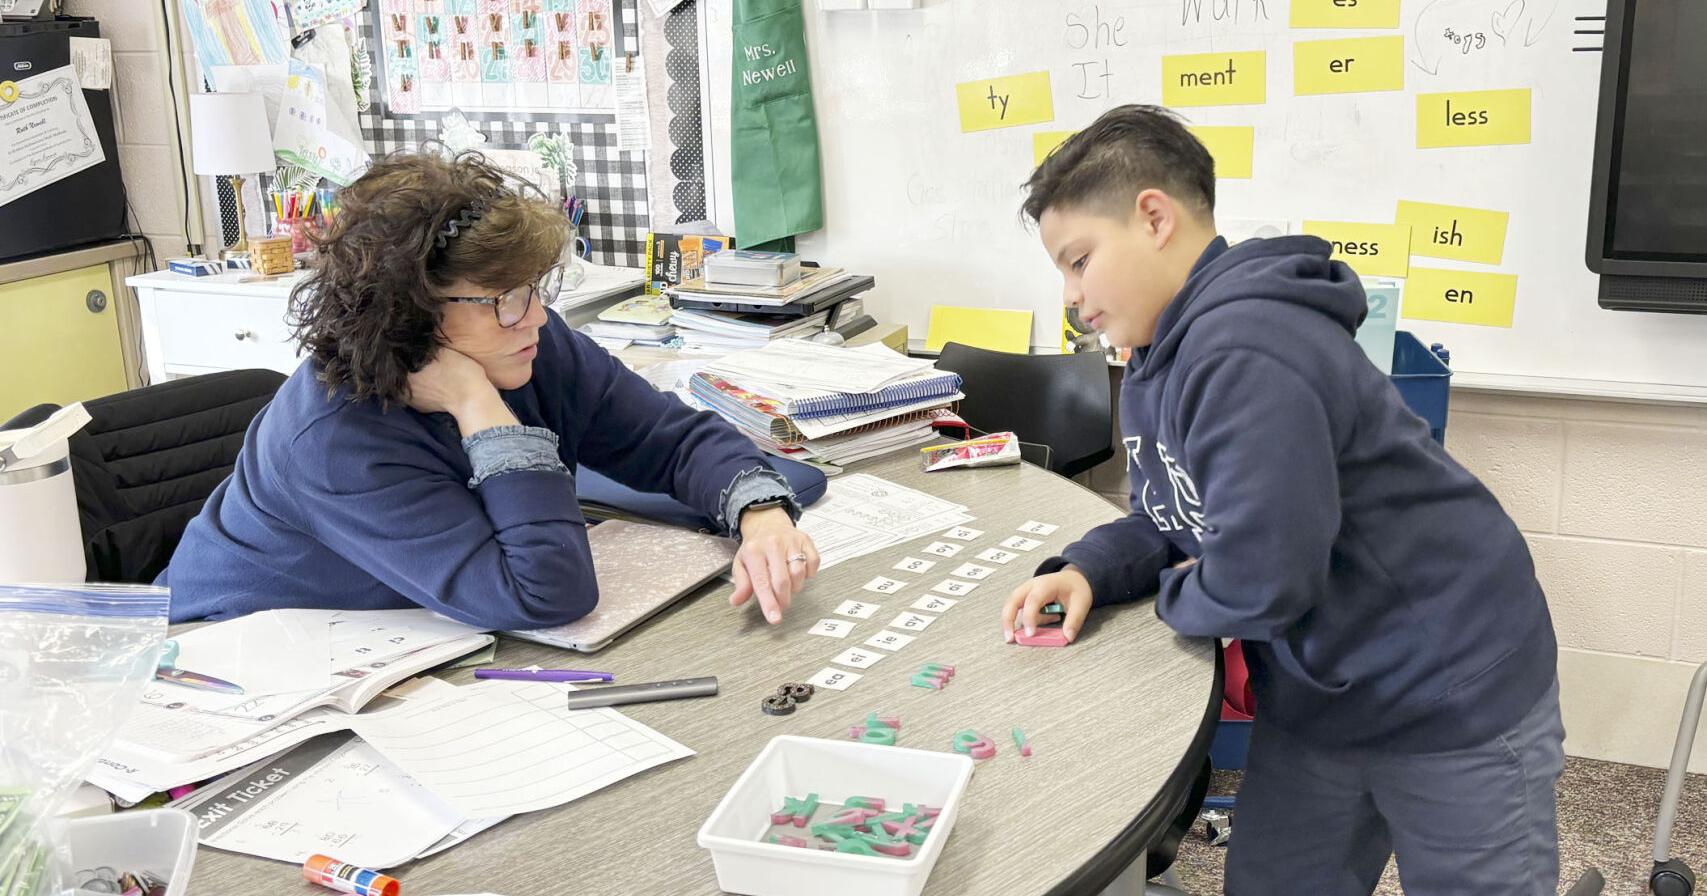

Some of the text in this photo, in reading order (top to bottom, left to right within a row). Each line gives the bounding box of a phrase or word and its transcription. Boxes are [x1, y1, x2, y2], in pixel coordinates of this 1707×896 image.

[1065, 5, 1128, 49] She
[744, 44, 776, 61] Mrs.
[743, 59, 796, 86] Newell
[1180, 59, 1237, 87] ment
[1329, 58, 1354, 73] er
[1072, 59, 1114, 99] It
[987, 85, 1009, 120] ty
[1446, 99, 1488, 126] less
[1433, 219, 1463, 246] ish
[1332, 240, 1379, 256] ness
[666, 251, 680, 281] chewy
[1367, 294, 1388, 319] 2
[1445, 289, 1473, 304] en
[926, 599, 945, 609] ey
[904, 616, 924, 627] ay
[876, 636, 897, 645] ie
[851, 652, 867, 663] ei
[825, 673, 845, 685] ea
[226, 767, 290, 803] Ticket
